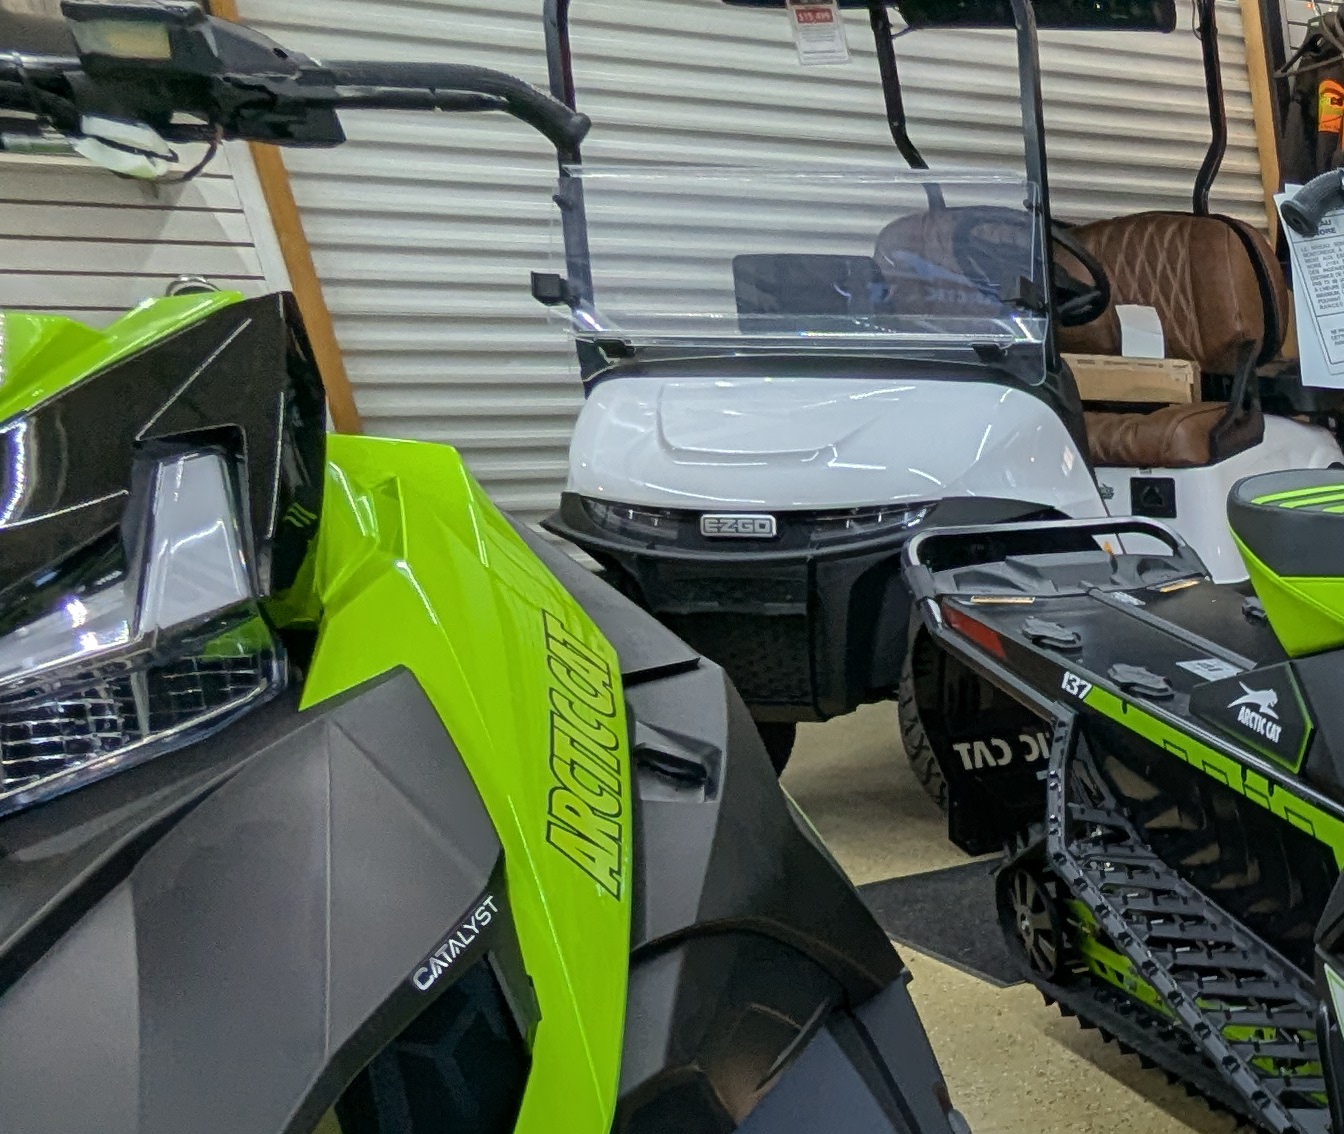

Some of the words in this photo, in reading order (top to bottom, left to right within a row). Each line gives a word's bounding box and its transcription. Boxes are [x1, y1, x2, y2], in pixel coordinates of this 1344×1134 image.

[704, 518, 771, 533] EZGO
[541, 608, 616, 718] CAT
[1061, 671, 1093, 699] 137
[1237, 706, 1266, 736] ARCTIC
[1265, 721, 1282, 743] CAT
[546, 687, 623, 901] ARCTIC
[413, 895, 498, 990] CATALYST
